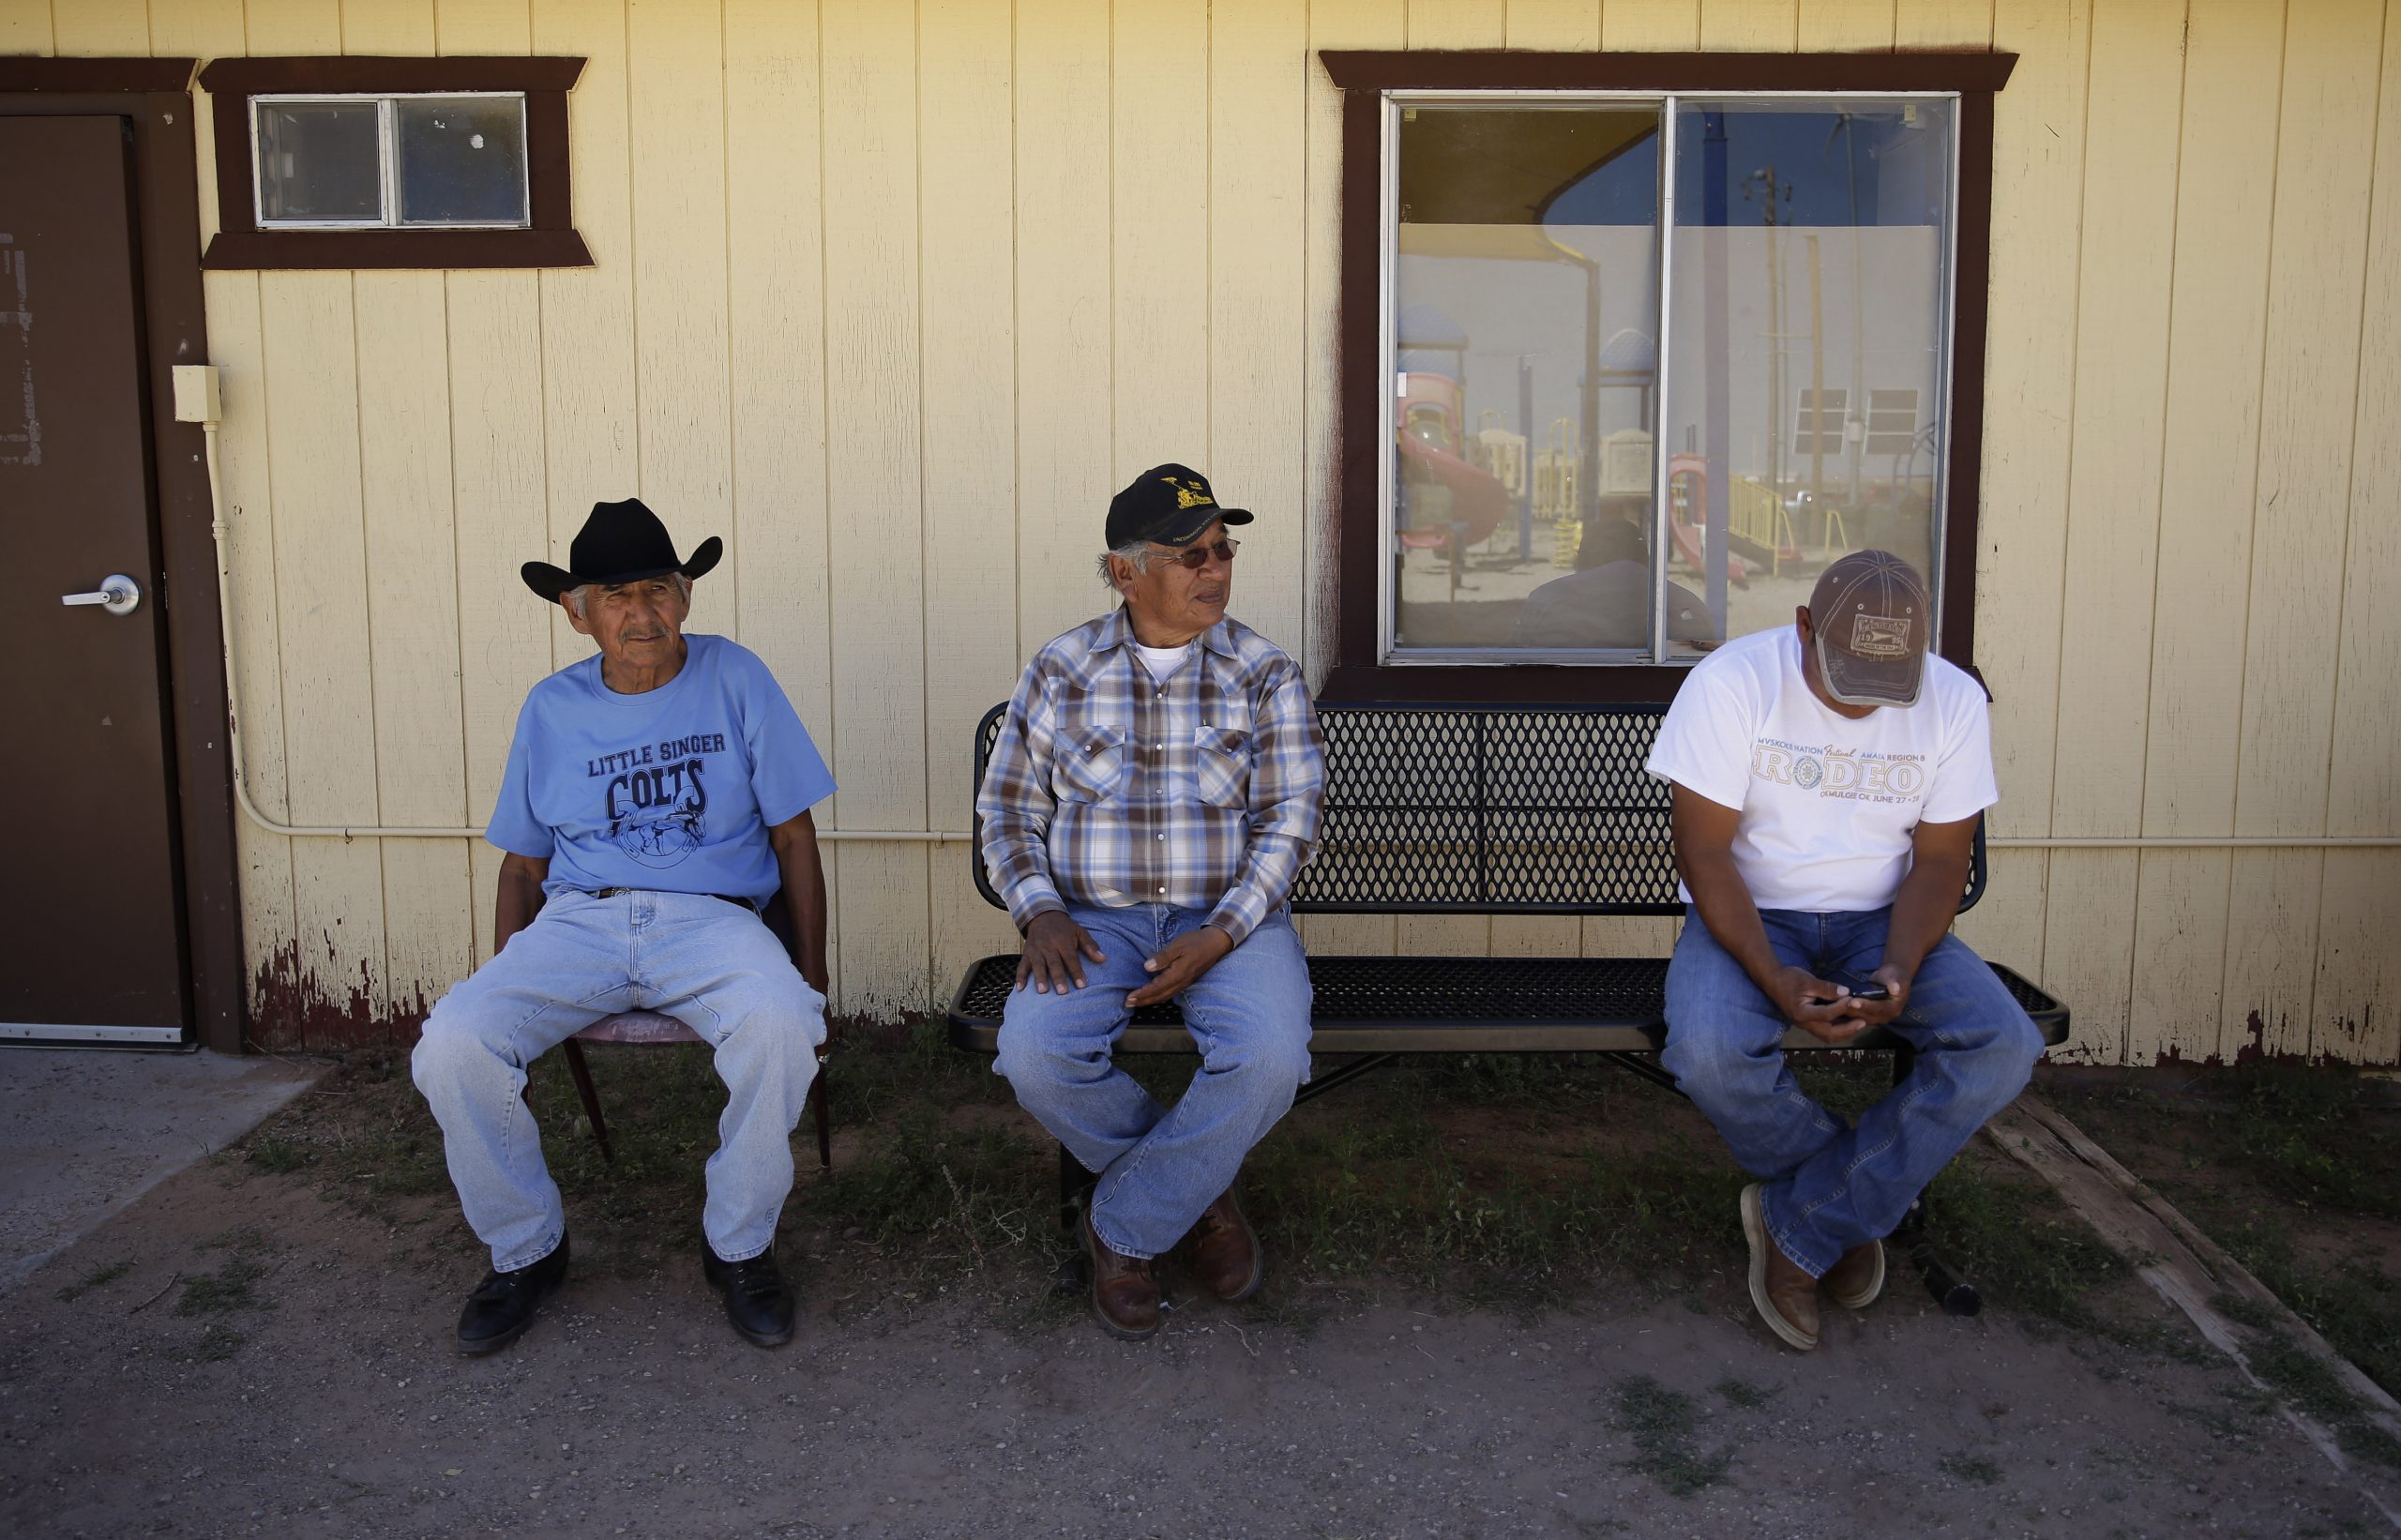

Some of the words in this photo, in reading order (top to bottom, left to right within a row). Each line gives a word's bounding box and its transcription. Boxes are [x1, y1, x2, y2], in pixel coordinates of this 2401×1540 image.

[588, 745, 653, 778] LITTLE
[659, 733, 726, 762] SINGER
[1753, 744, 1924, 795] RODEO
[1823, 744, 1857, 758] Festival
[606, 757, 709, 822] COLTS
[1858, 793, 1870, 802] OK
[1872, 795, 1894, 804] JUNE
